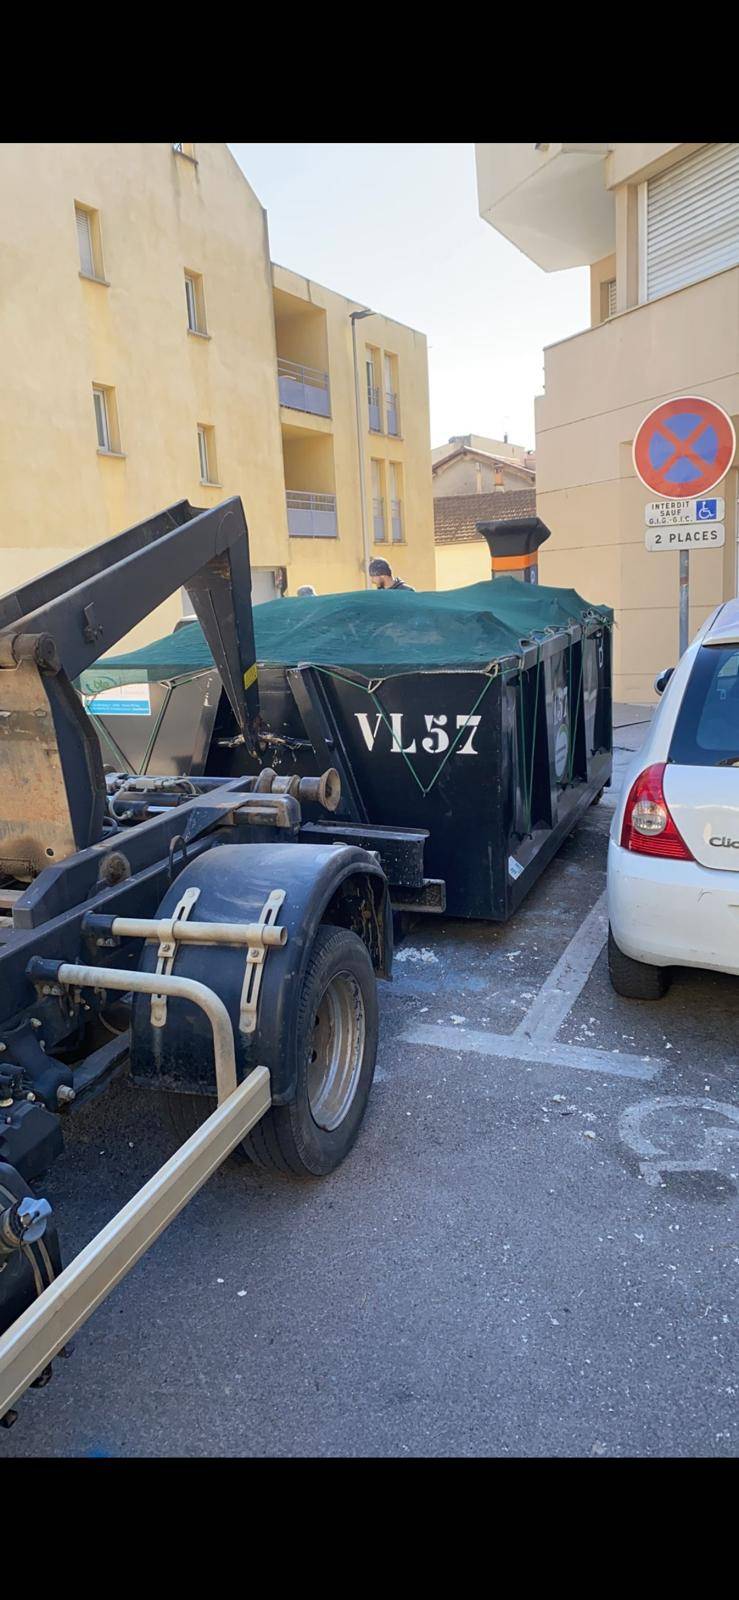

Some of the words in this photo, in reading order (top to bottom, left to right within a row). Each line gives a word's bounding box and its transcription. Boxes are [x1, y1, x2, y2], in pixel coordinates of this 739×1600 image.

[651, 501, 690, 510] INTERDIT
[660, 509, 682, 517] SAUF
[655, 534, 662, 544] 2
[669, 530, 718, 543] PLACES
[354, 712, 482, 754] VL57
